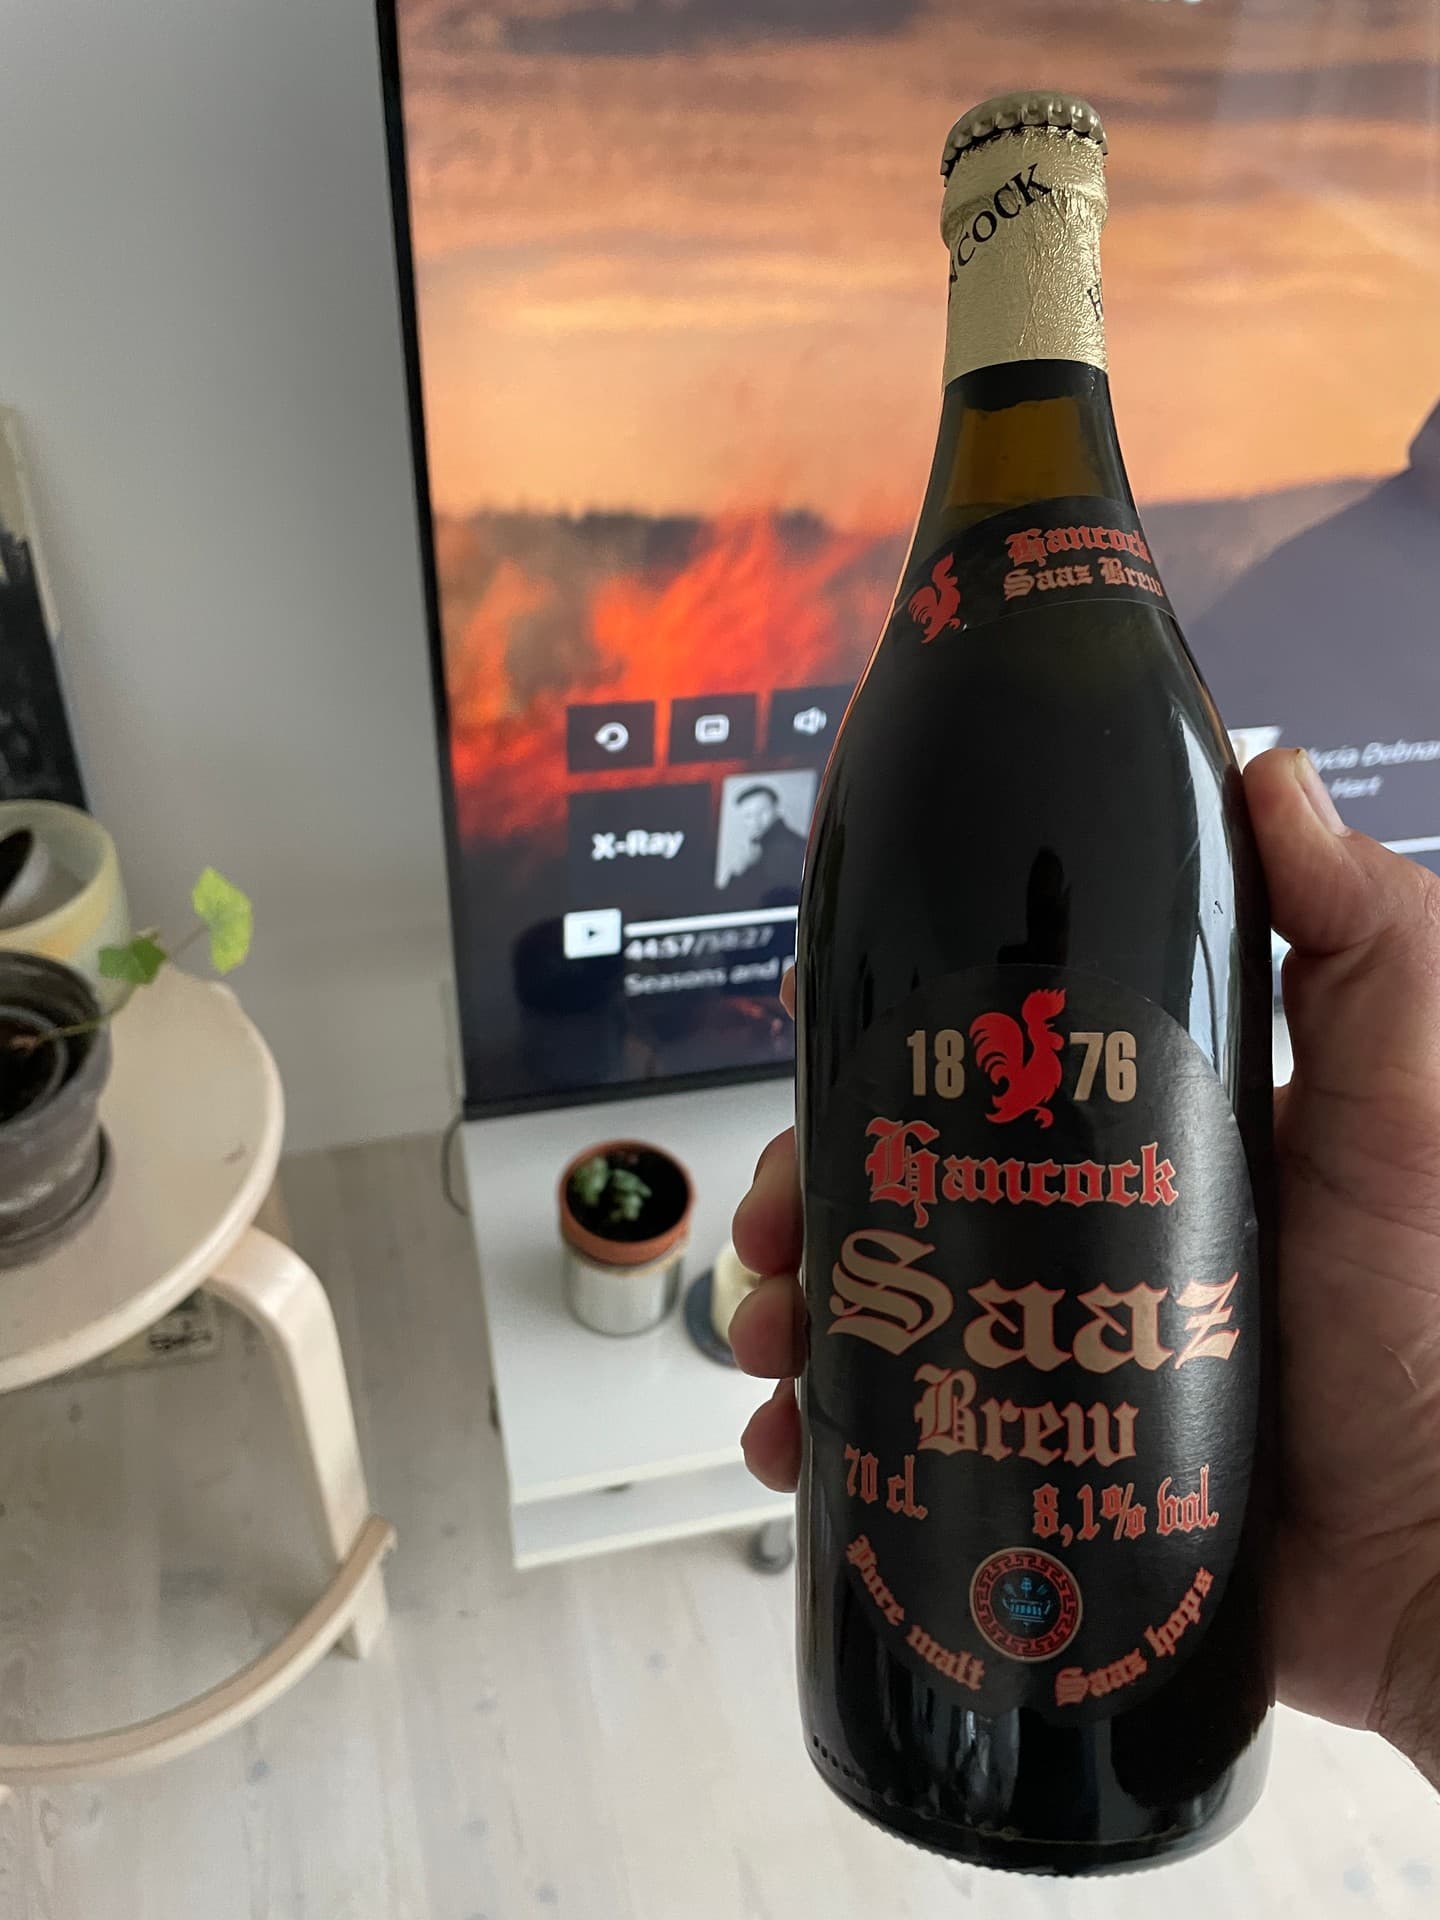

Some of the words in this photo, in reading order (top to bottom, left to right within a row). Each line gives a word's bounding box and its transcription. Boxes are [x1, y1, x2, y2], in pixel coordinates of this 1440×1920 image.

[1003, 563, 1093, 601] Saaz
[1097, 556, 1165, 597] Brew
[1004, 525, 1152, 566] Hancock
[591, 829, 684, 861] X-Ray
[906, 1029, 965, 1099] 18
[1069, 1031, 1137, 1103] 76
[865, 1116, 1179, 1229] Hancock
[827, 1228, 1240, 1373] Saaz
[913, 1363, 1140, 1468] Brew
[844, 1443, 879, 1505] 70
[886, 1454, 929, 1520] cl.
[1032, 1482, 1147, 1548] 8,1%
[845, 1534, 905, 1627] Pure
[906, 1624, 986, 1691] malt
[1055, 1648, 1148, 1707] Saaz
[1143, 1566, 1215, 1658] hops
